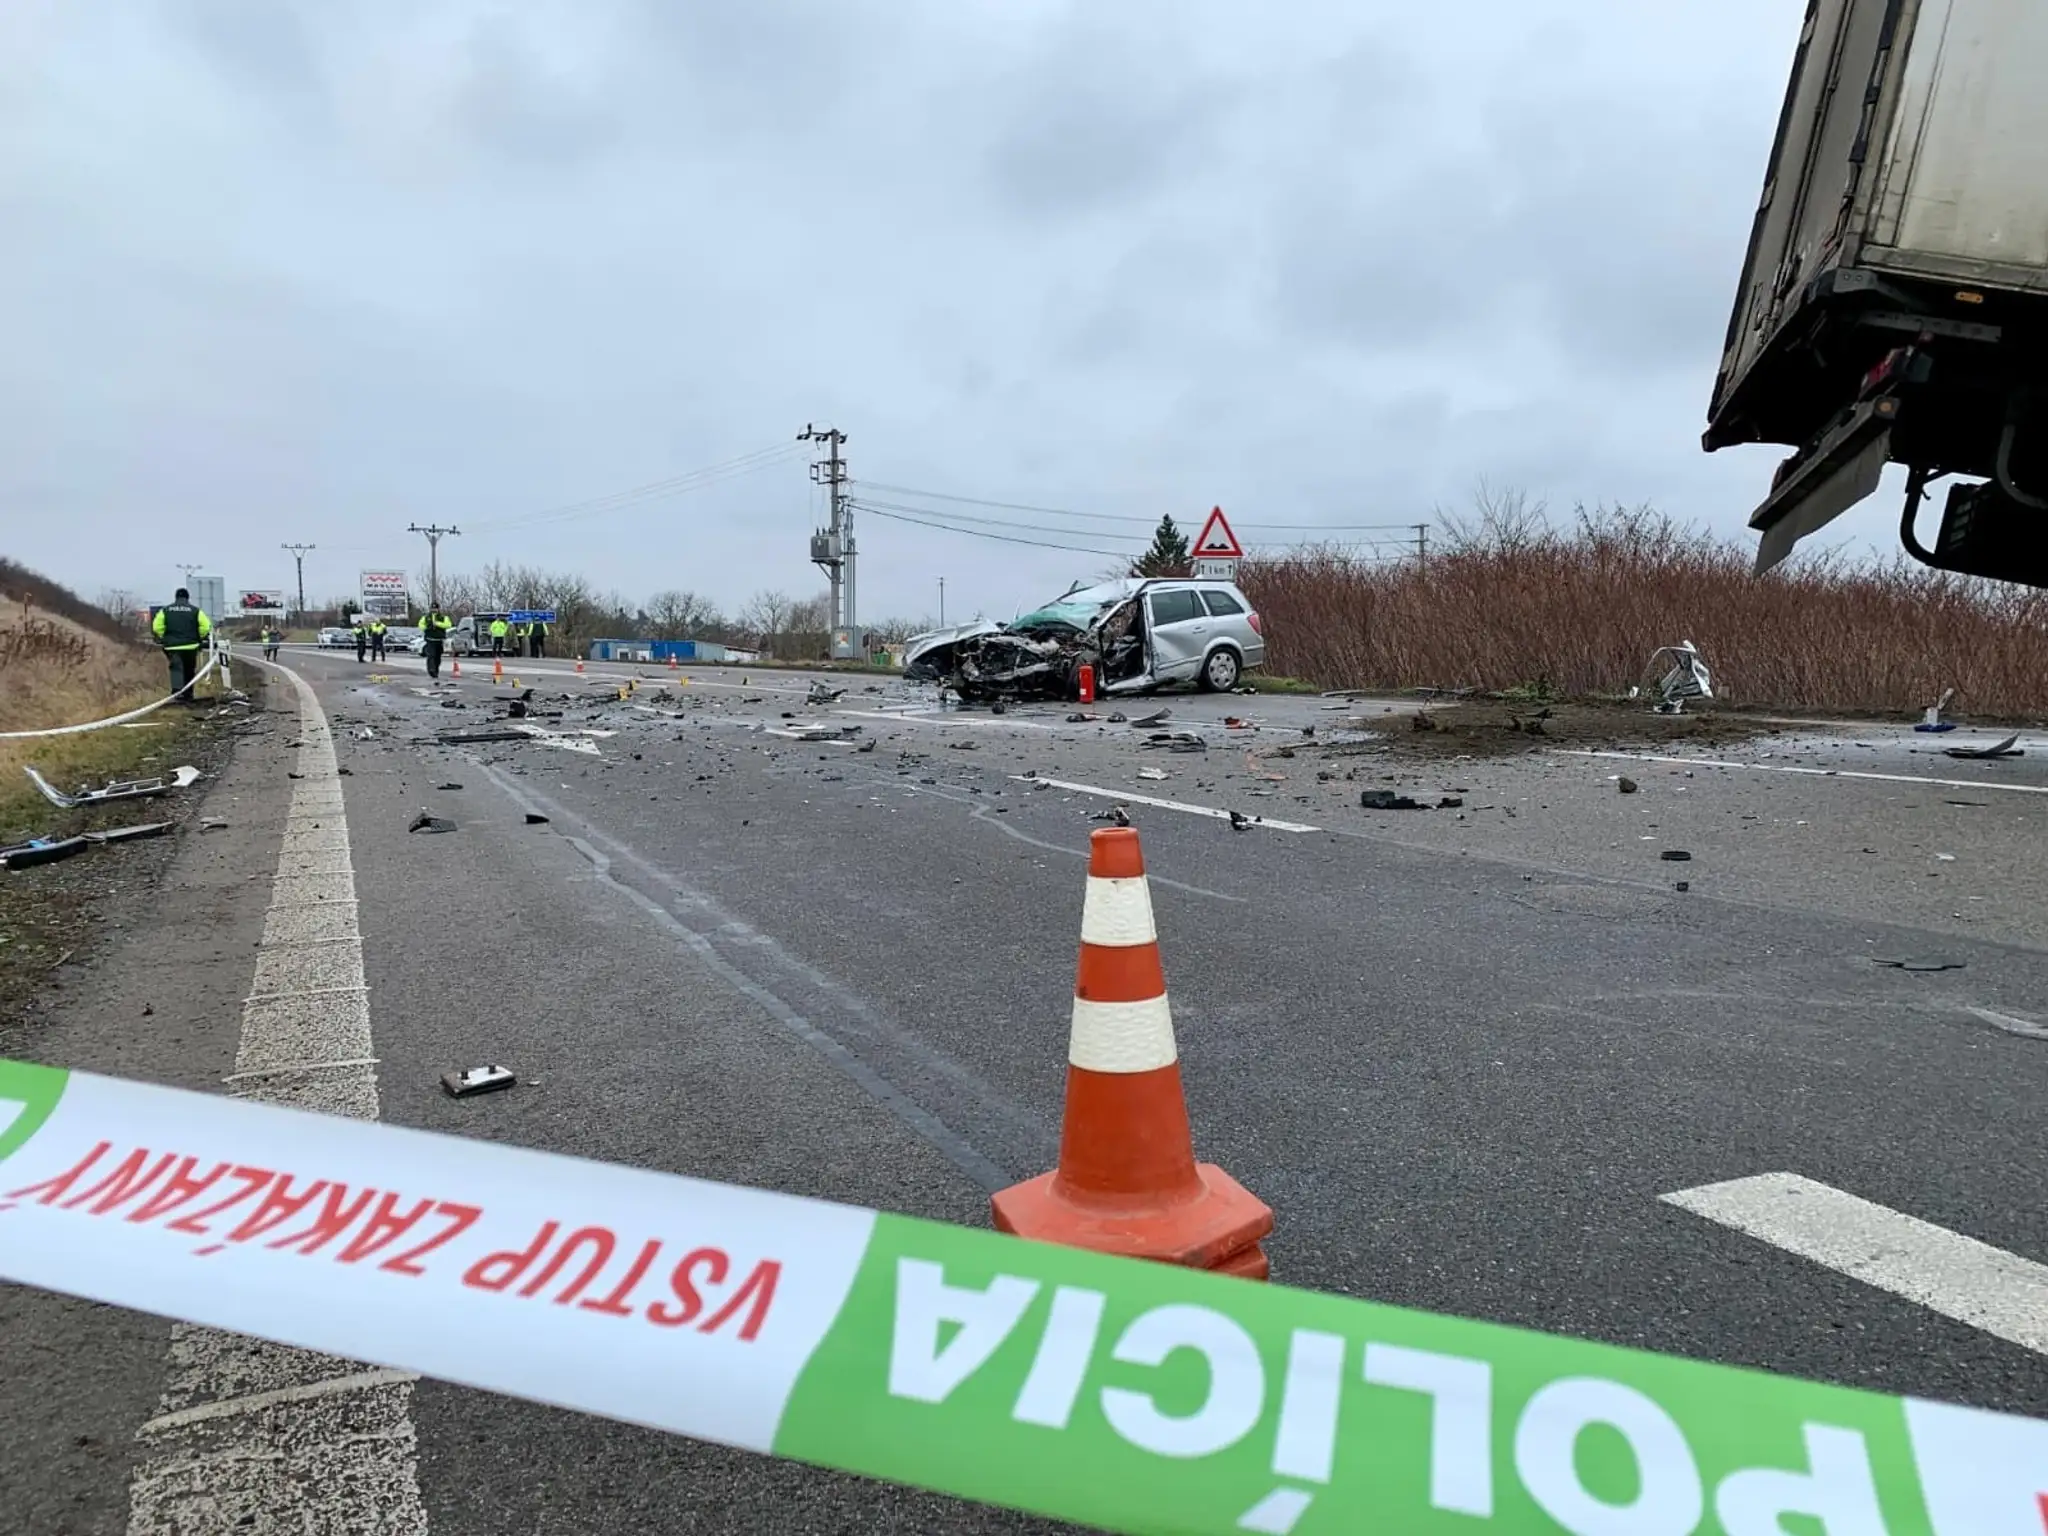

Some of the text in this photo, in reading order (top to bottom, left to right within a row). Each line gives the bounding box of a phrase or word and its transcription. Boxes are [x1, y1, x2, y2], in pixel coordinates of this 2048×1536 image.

[0, 1138, 781, 1340] VSTUP ZAKÁZANÝ
[890, 1258, 1888, 1536] POLÍCIA
